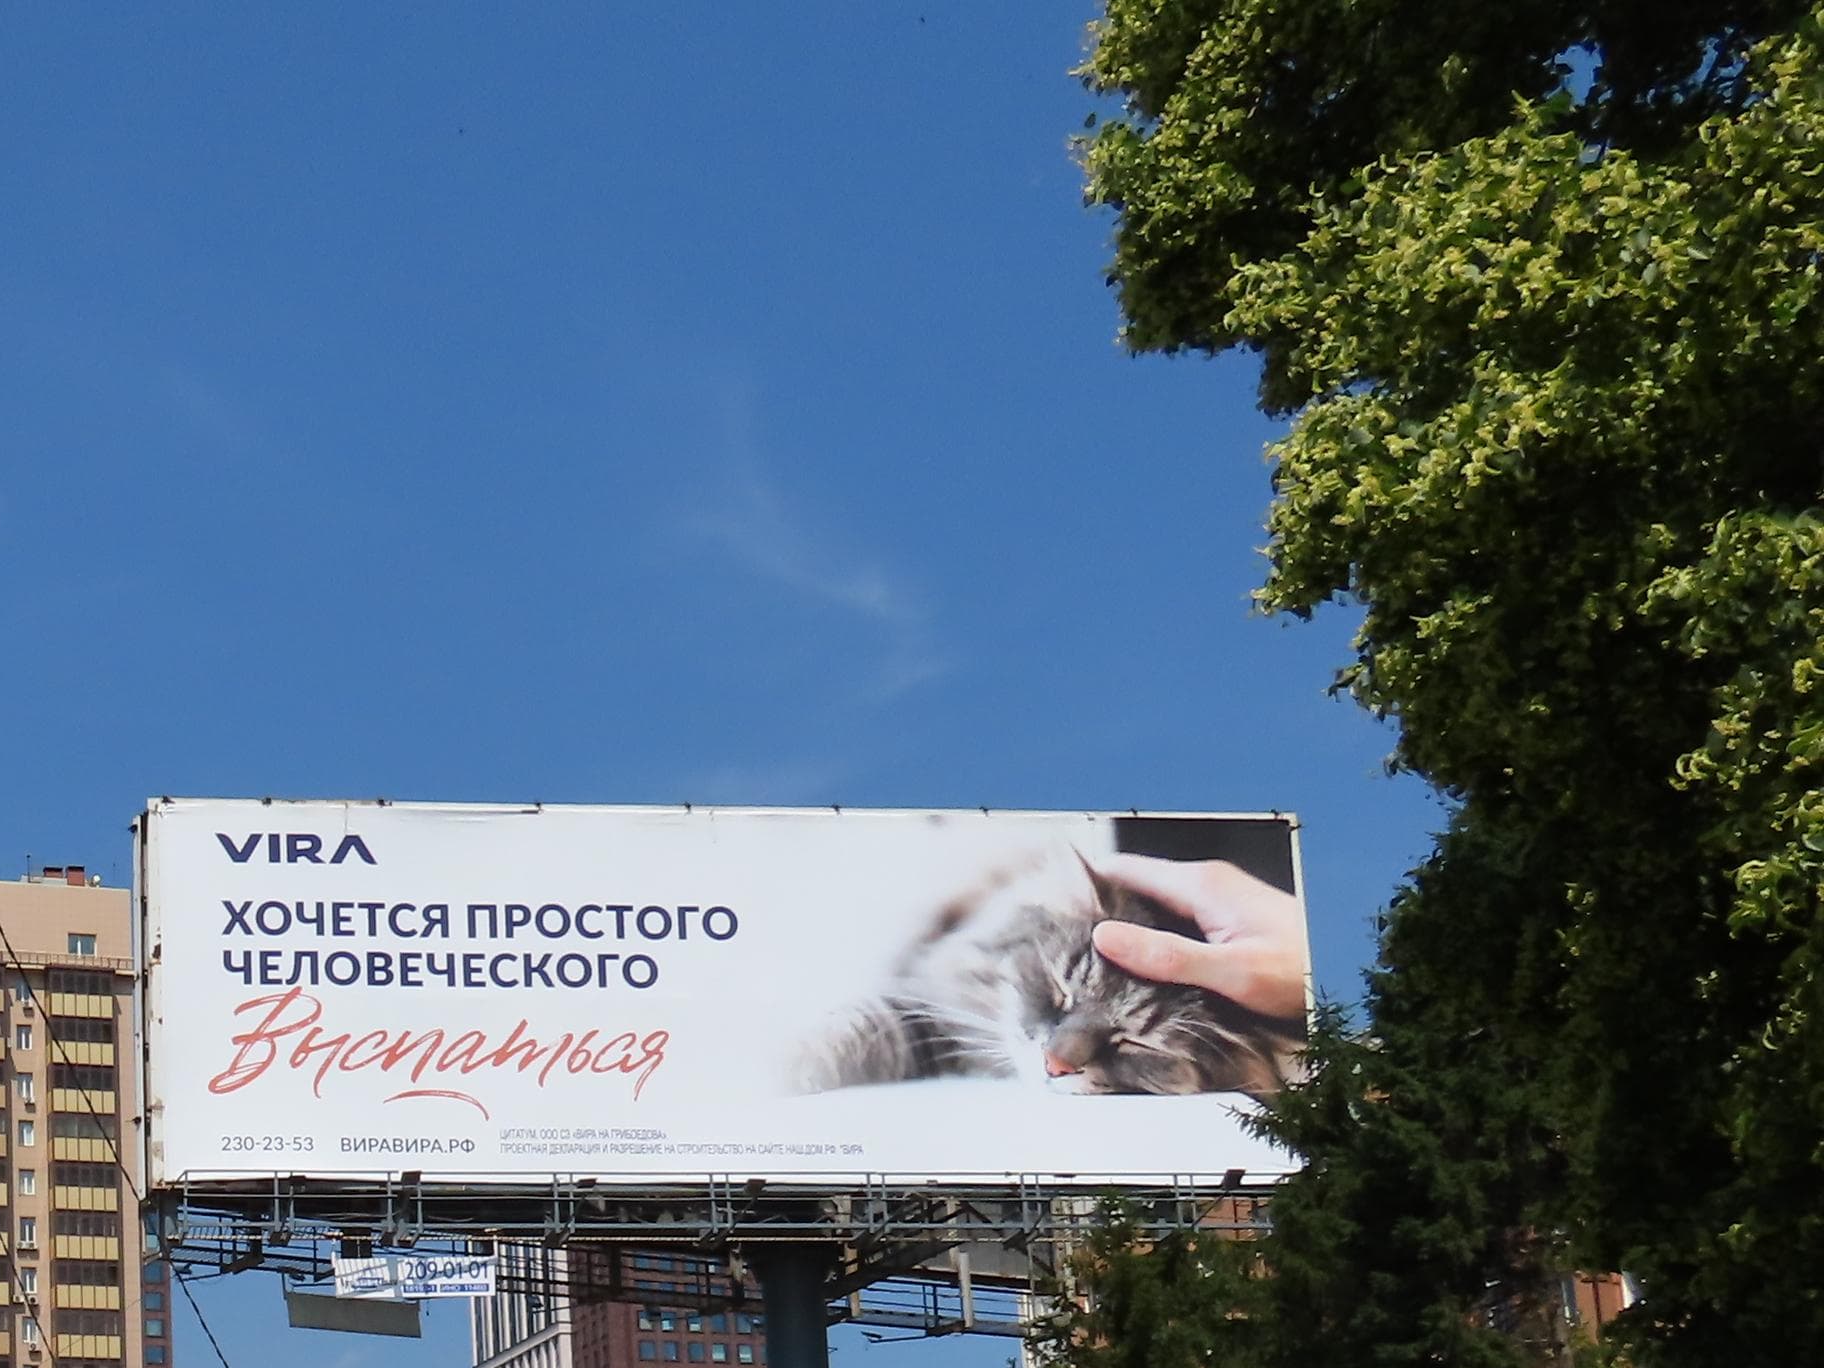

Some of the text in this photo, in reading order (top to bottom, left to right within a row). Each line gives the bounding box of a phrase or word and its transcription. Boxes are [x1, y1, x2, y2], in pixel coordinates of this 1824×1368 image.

[214, 831, 378, 865] VIRA
[222, 900, 739, 942] ХОЧЕТСЯ ПРОСТОГО
[222, 949, 659, 989] ЧЕЛОВЕЧЕСКОГО
[207, 985, 670, 1102] Выспаться
[220, 1135, 476, 1154] 230-23-53 ВИРАВИРА.РФ
[499, 1143, 548, 1155] ПРОЕКТНАЯ
[405, 1261, 489, 1280] 209-01-01
